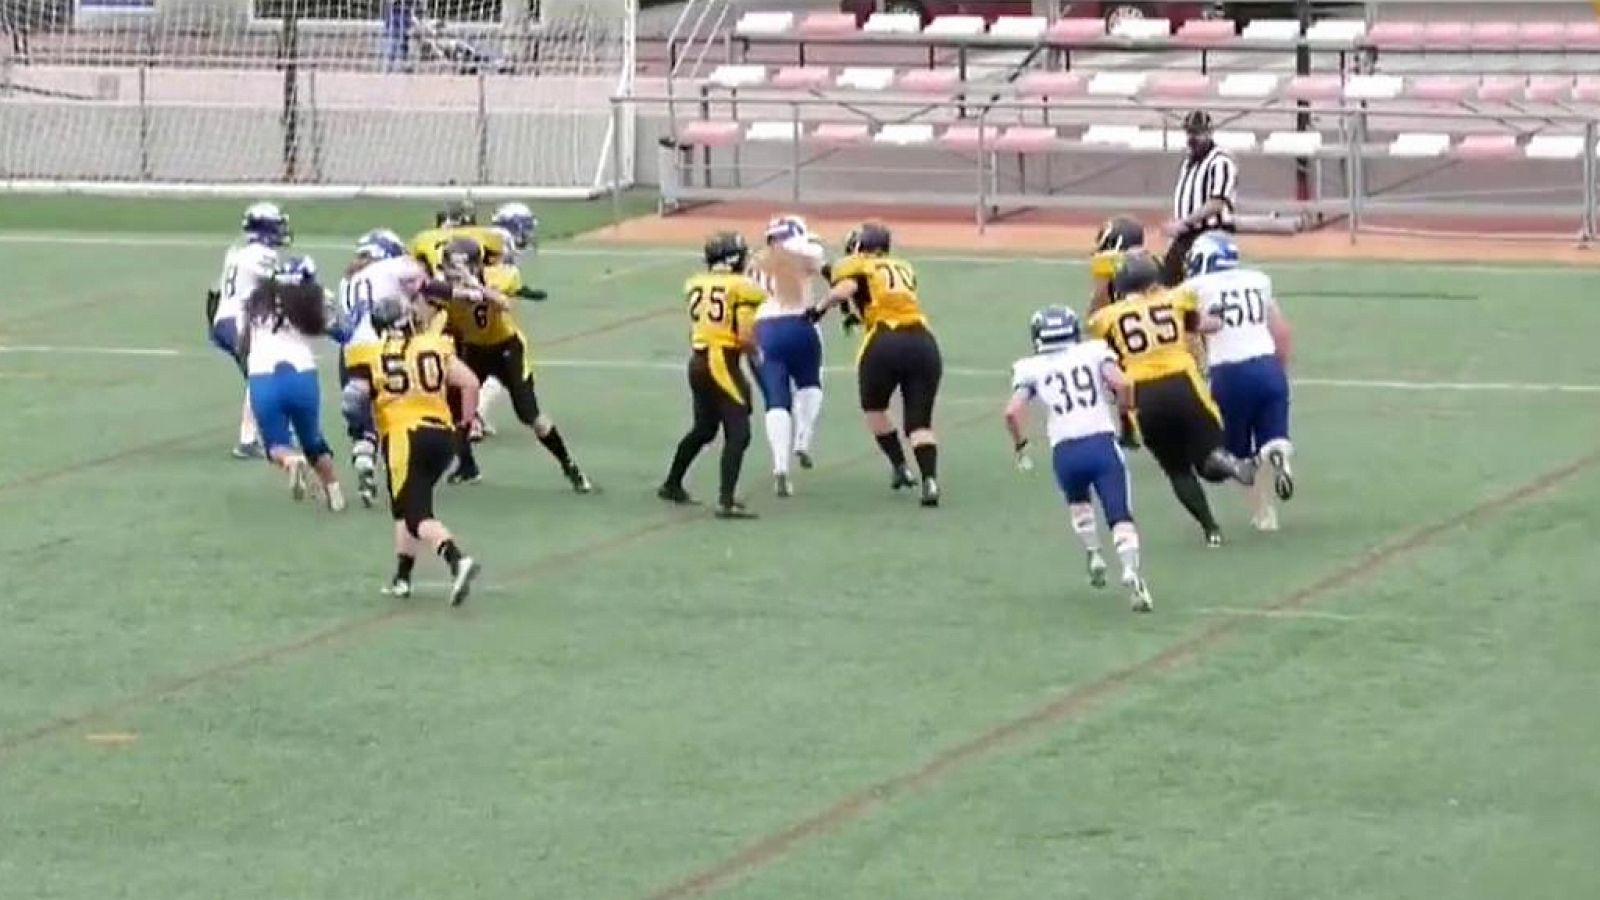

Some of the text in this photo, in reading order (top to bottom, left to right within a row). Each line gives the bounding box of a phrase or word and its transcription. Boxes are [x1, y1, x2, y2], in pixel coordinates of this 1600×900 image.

[688, 285, 725, 322] 25
[1118, 303, 1178, 354] 65
[381, 350, 443, 394] 50
[1045, 364, 1097, 415] 39
